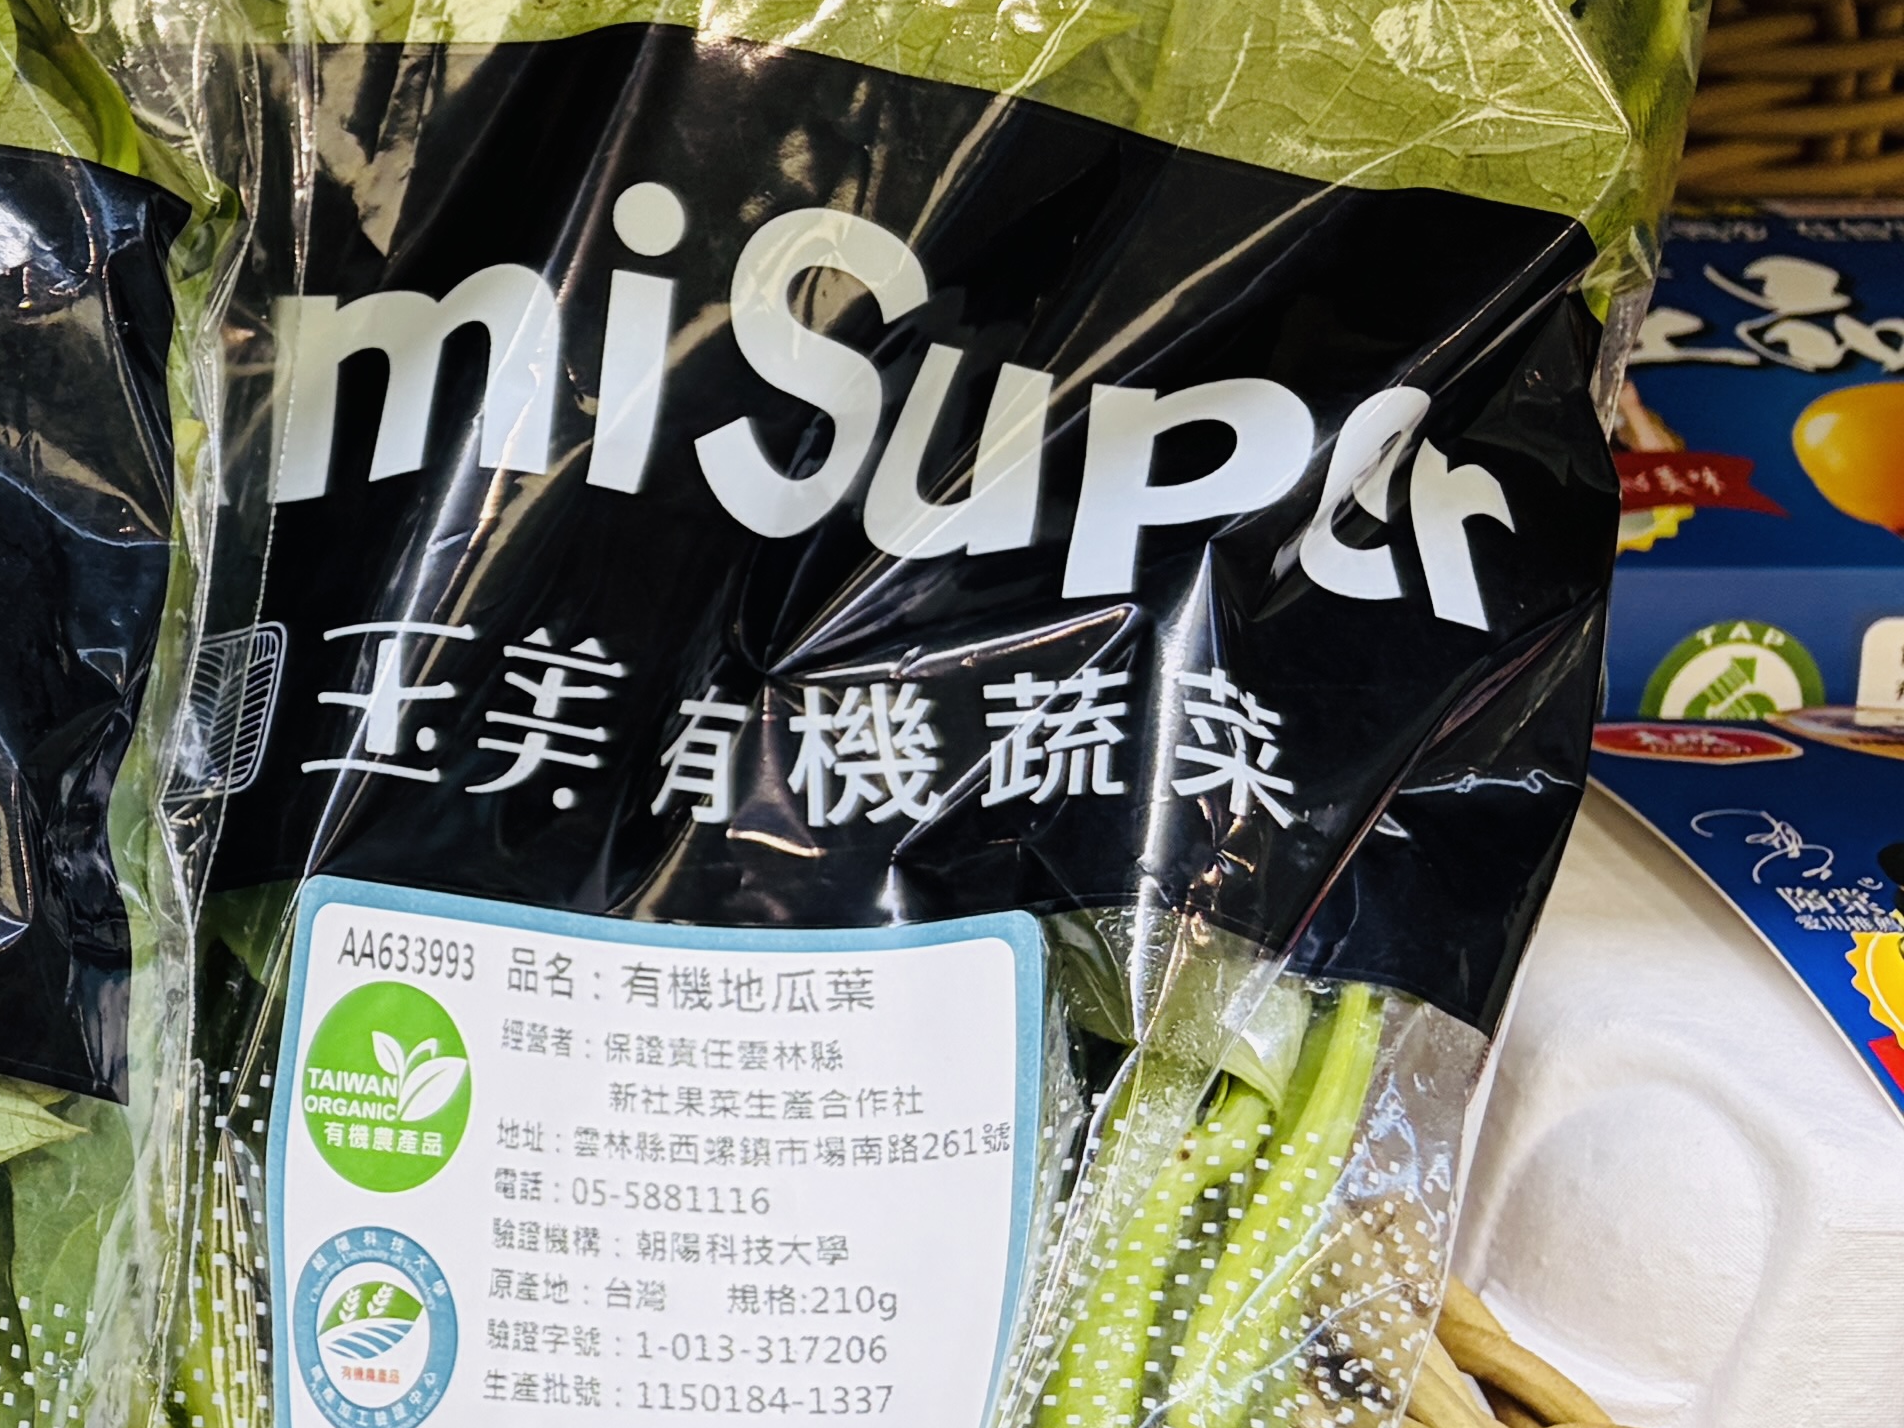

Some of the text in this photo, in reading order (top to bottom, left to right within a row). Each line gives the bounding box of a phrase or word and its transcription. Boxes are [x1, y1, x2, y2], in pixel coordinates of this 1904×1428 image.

[337, 925, 476, 982] AA633993
[307, 1066, 399, 1100] TAIWAN
[303, 1094, 398, 1123] ORGANIC
[323, 1121, 443, 1159] 有機農產品
